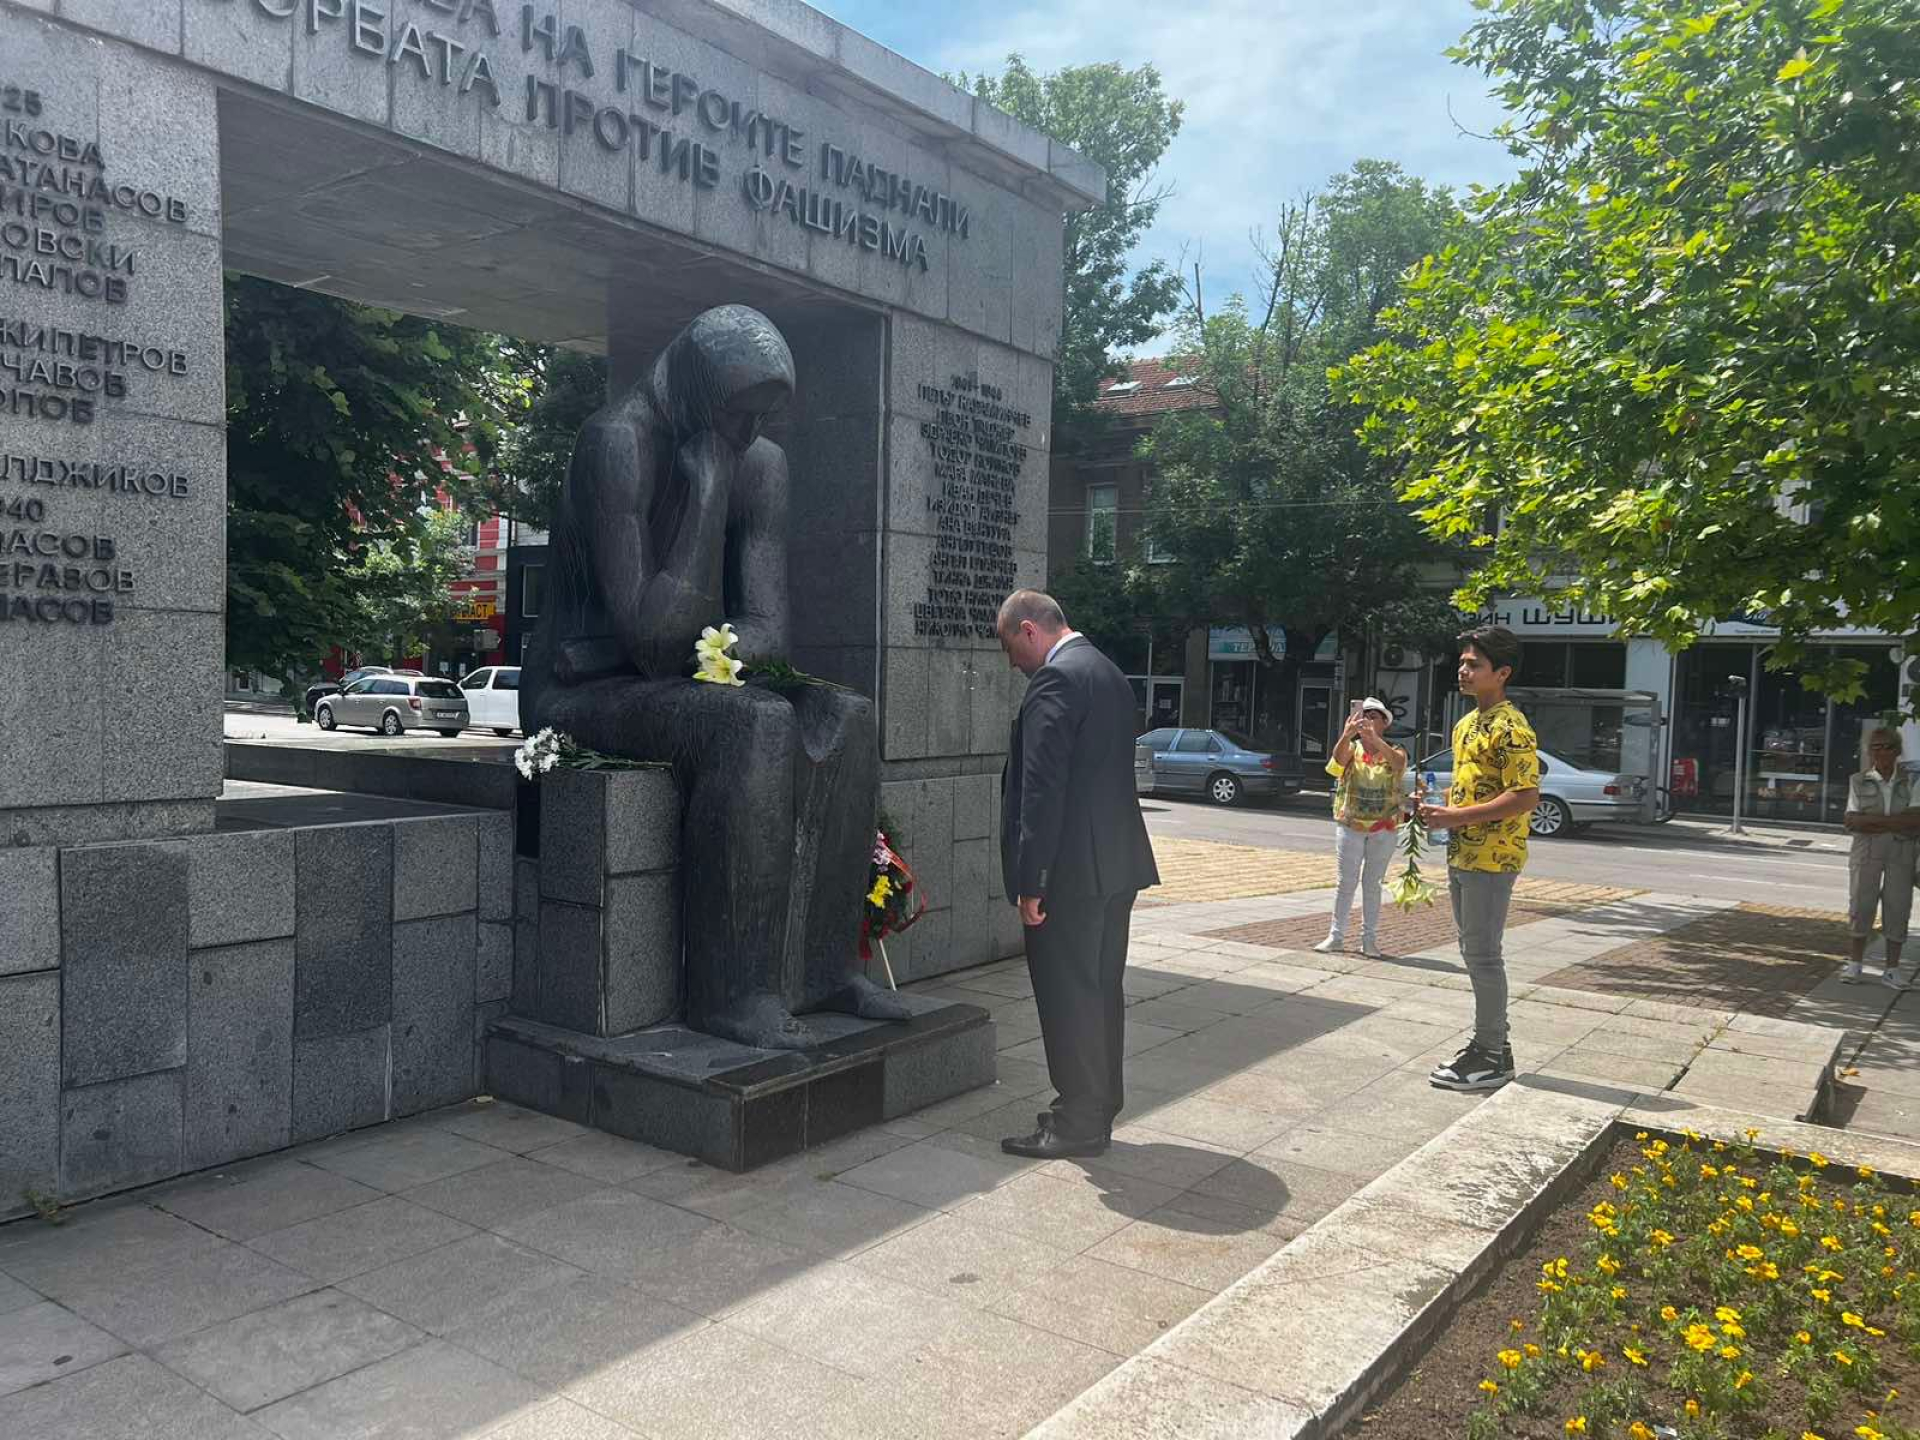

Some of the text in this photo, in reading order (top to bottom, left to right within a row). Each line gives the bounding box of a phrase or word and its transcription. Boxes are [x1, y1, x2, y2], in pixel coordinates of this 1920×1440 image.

[521, 4, 595, 77] НА
[616, 48, 804, 169] ГЕРОИТЕ
[821, 142, 970, 241] ПАДНАЛИ
[527, 73, 721, 190] ПРОТИВ
[742, 163, 930, 272] ФАШИЗМА
[0, 528, 117, 562] АСОВ
[1462, 611, 1511, 625] ЗИН
